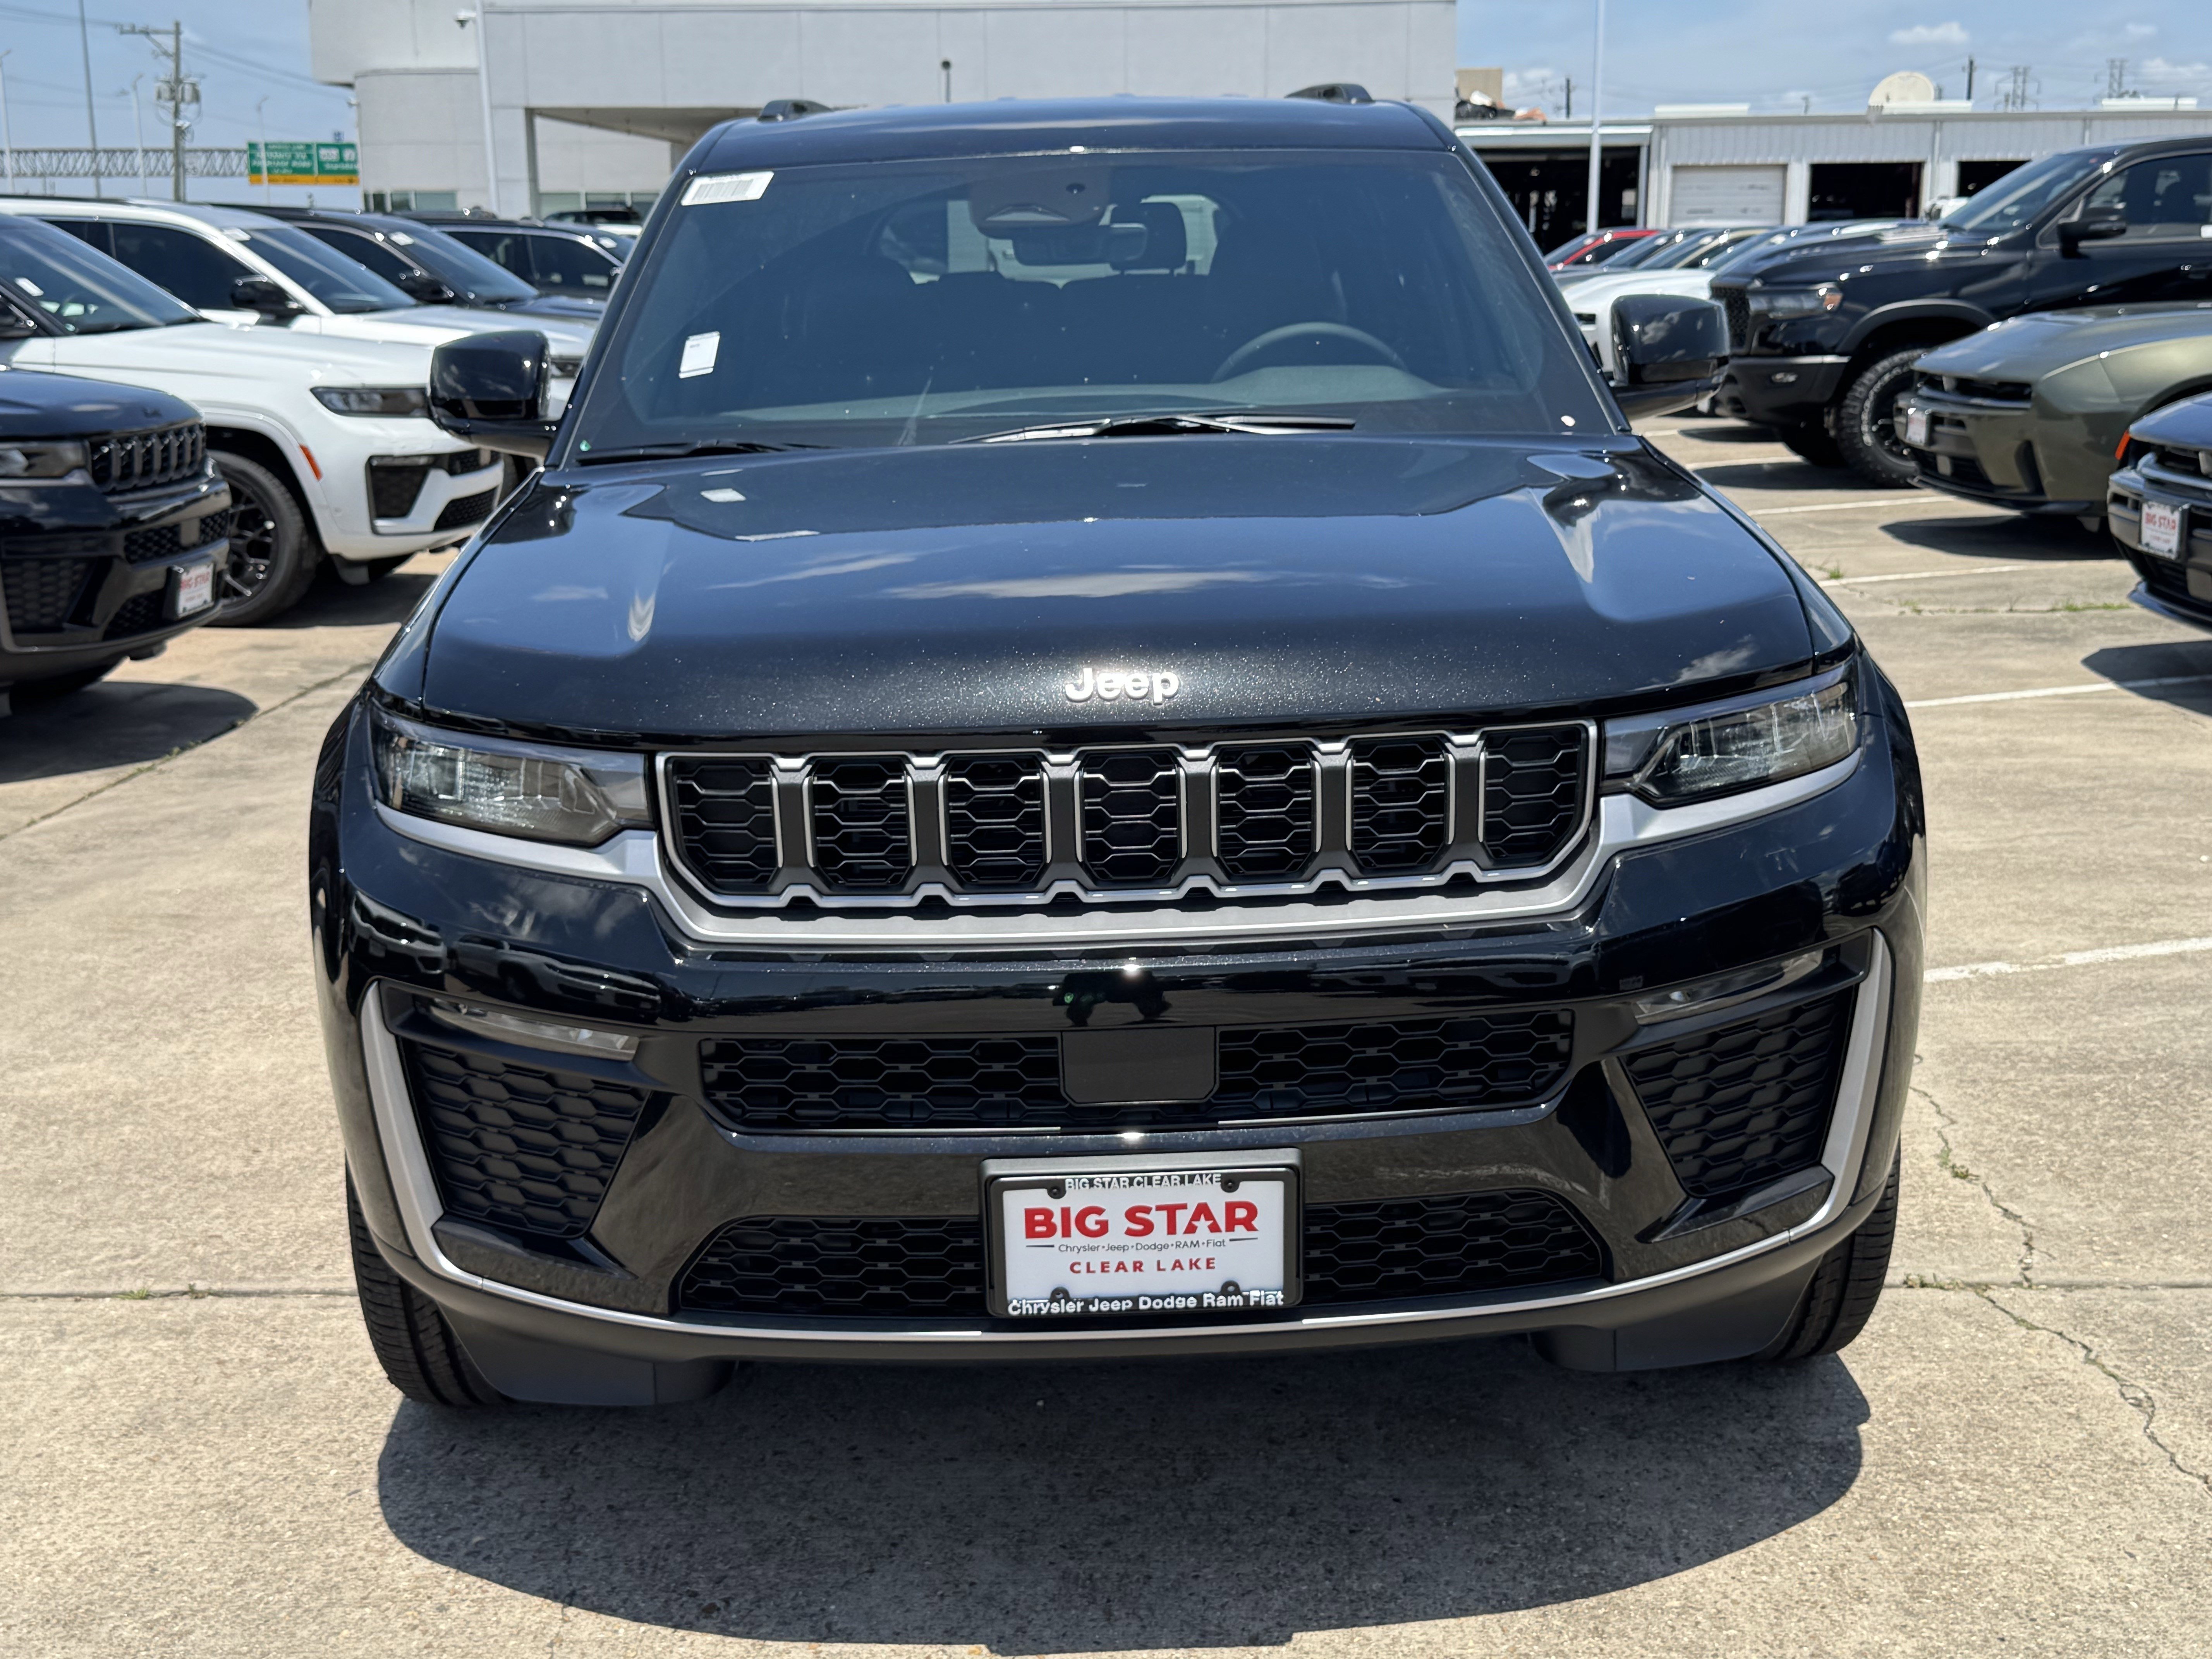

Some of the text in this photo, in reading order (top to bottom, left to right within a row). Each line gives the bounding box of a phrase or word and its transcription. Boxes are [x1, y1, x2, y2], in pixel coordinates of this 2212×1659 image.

[1065, 668, 1179, 705] Jeep
[1065, 1173, 1221, 1190] BIG STAR CLEAR LAKE
[1024, 1200, 1259, 1239] BIG STAR
[1070, 1257, 1216, 1273] CLEAR LAKE
[1008, 1290, 1284, 1316] Chrysler Jeep Dodge Ram Fiat
